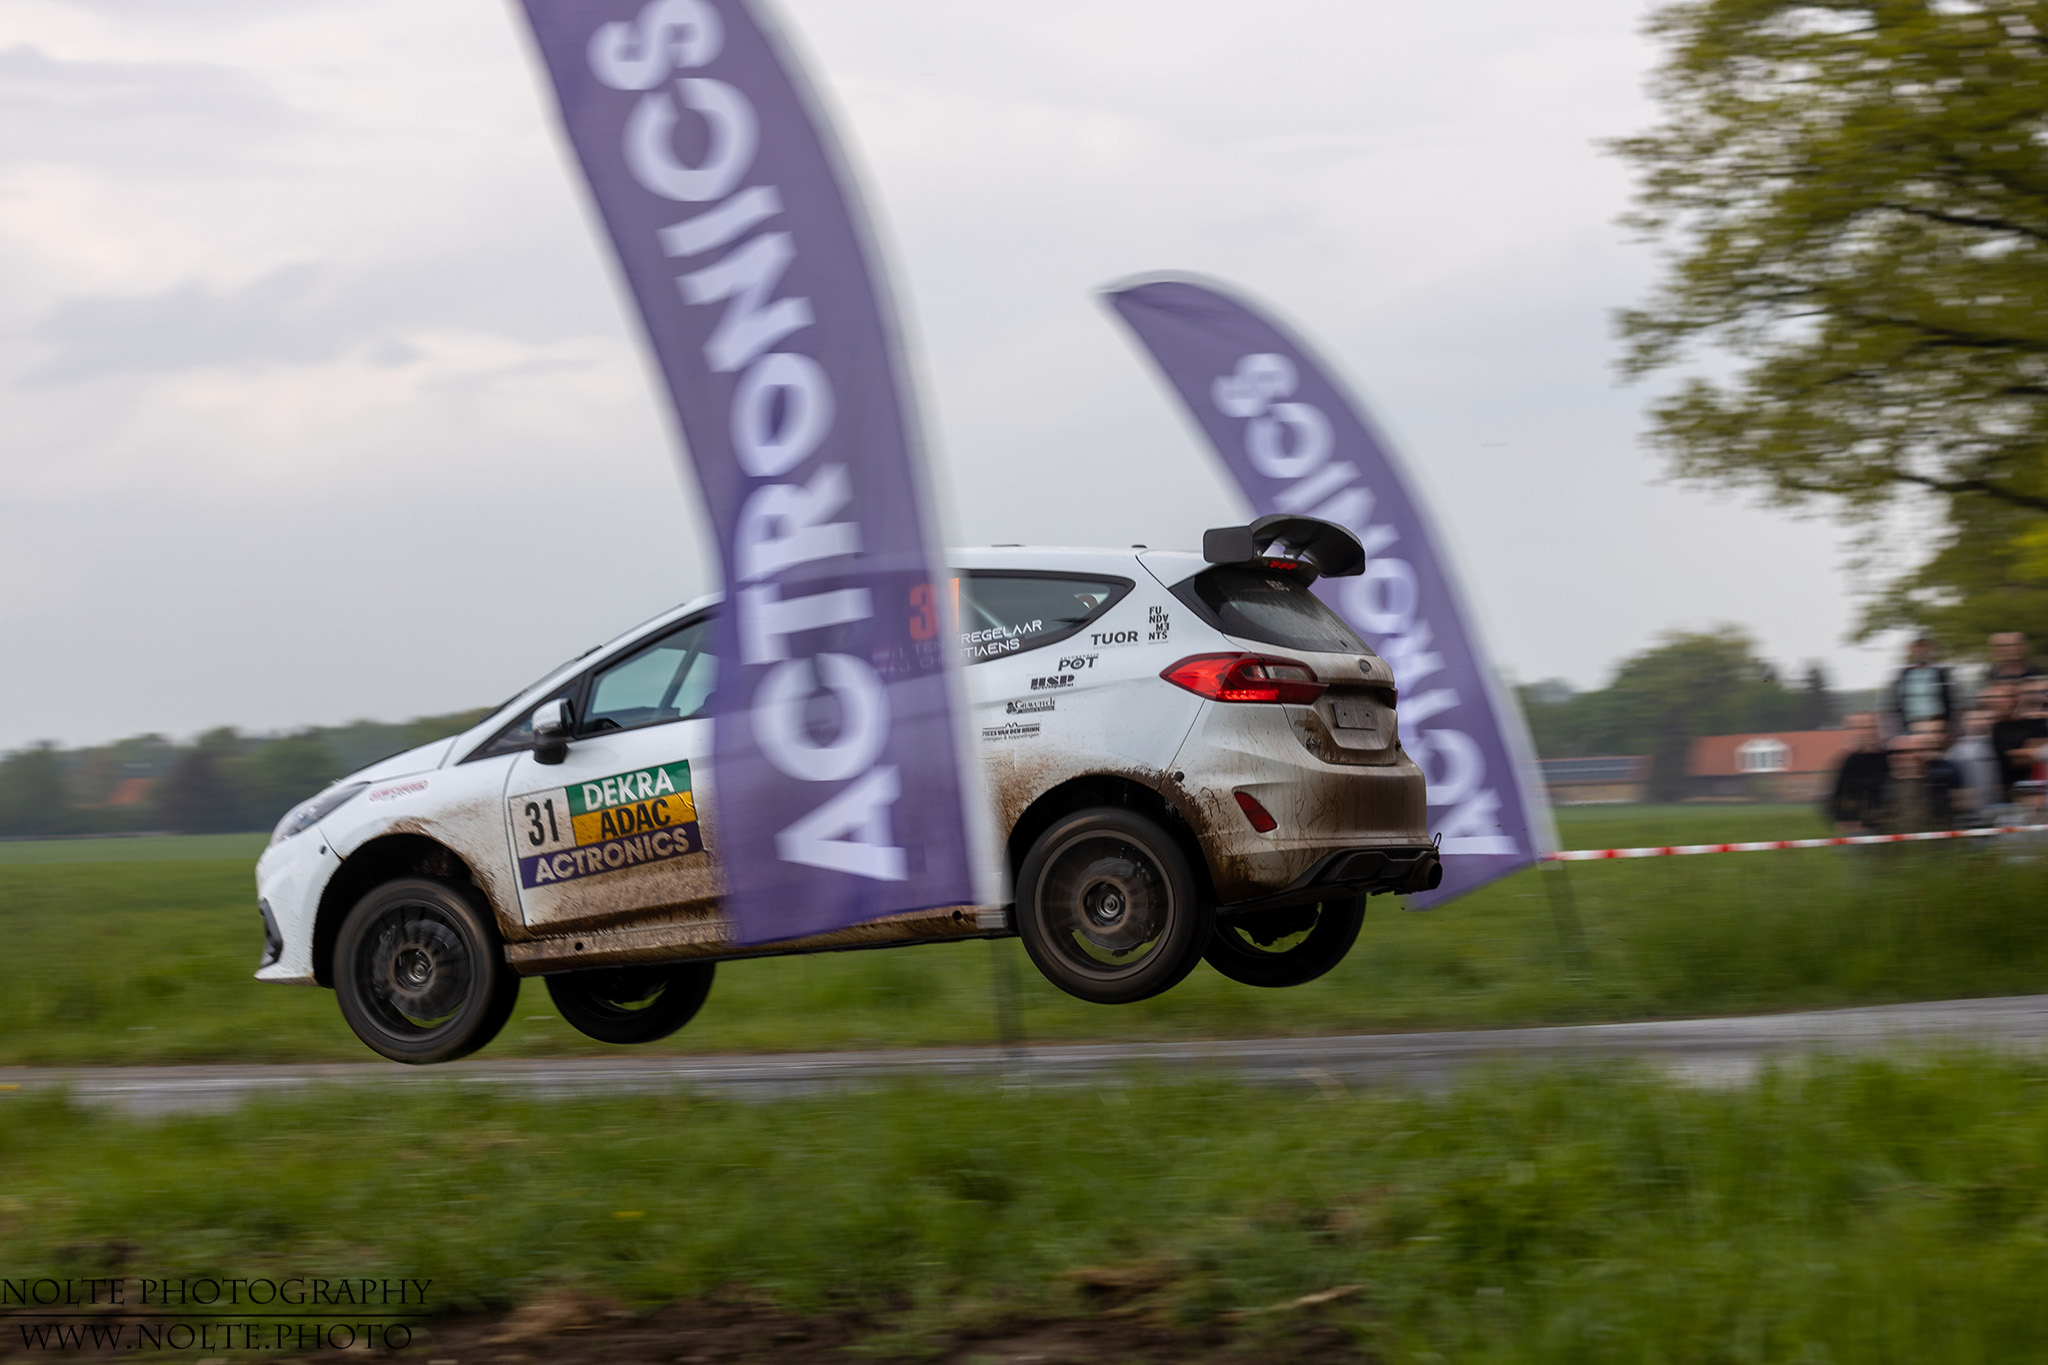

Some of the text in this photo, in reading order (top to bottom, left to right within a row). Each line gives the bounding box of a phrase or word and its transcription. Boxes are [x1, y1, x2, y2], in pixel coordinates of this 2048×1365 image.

[586, 0, 909, 882] ACTRONICS
[1091, 630, 1139, 646] TUOR
[1058, 656, 1099, 672] POT
[581, 766, 676, 812] DEKRA
[525, 798, 560, 847] 31
[601, 797, 671, 840] ADAC
[535, 827, 690, 884] ACTRONICS
